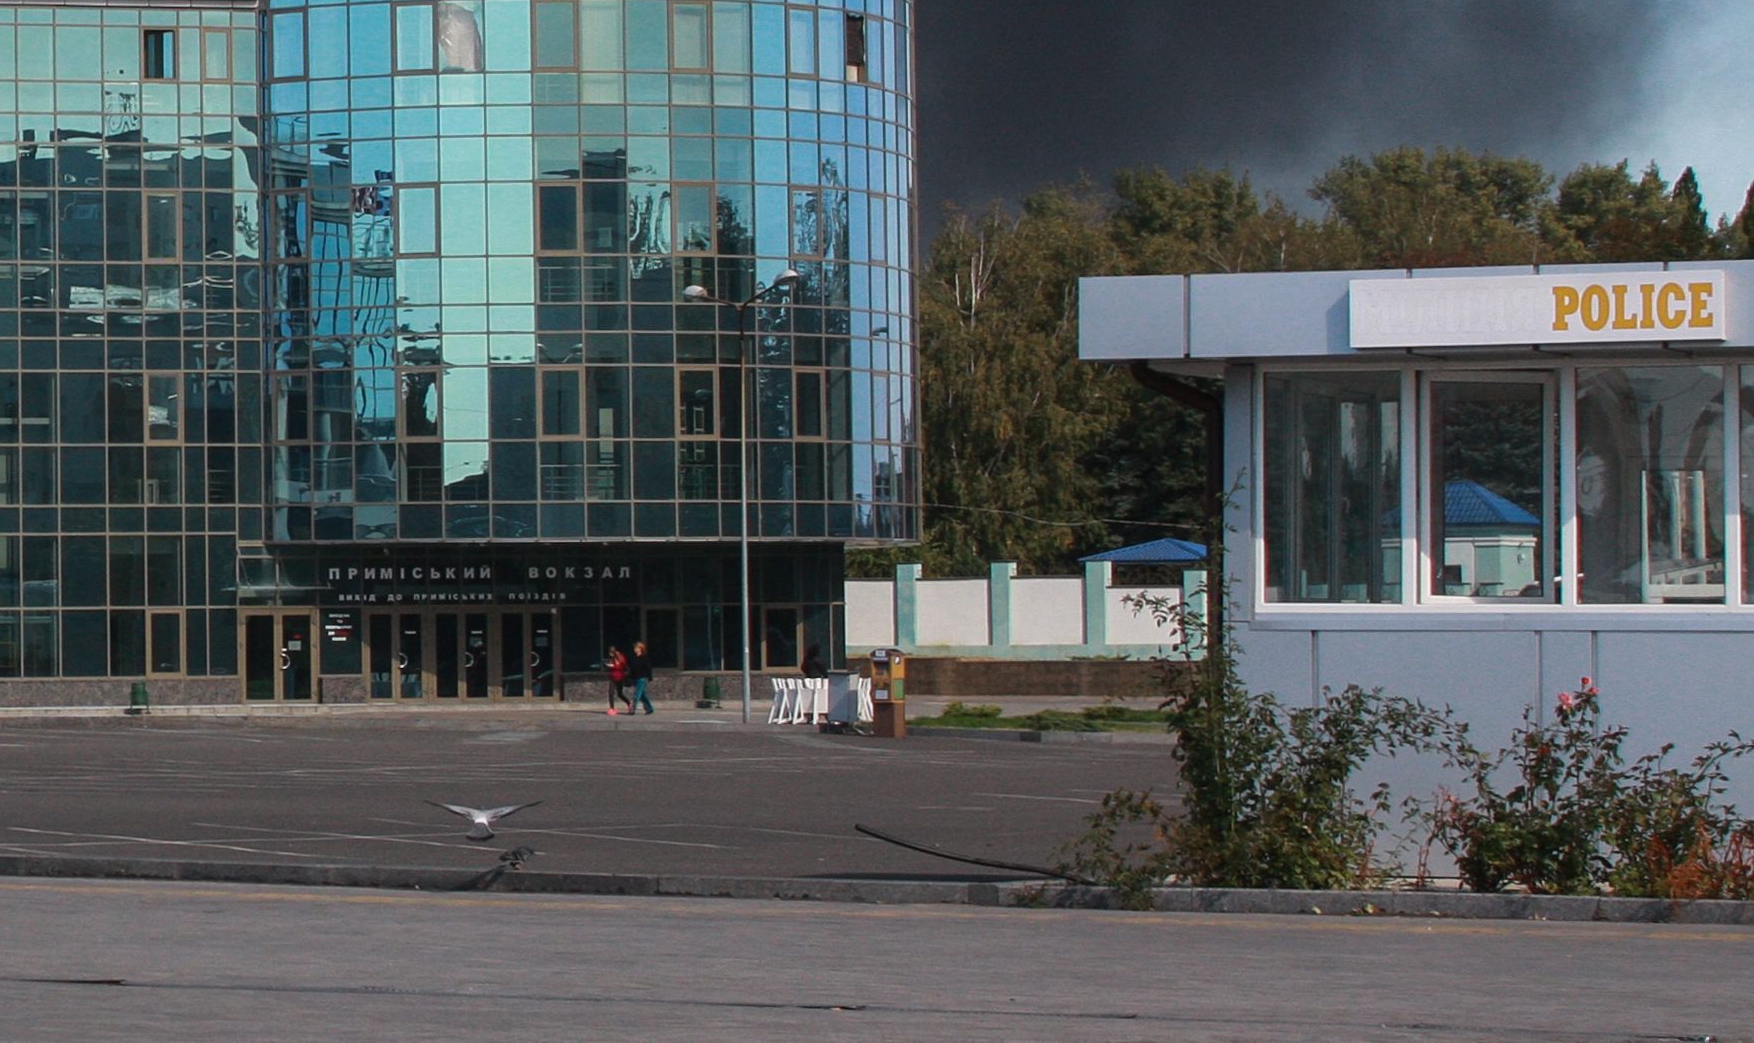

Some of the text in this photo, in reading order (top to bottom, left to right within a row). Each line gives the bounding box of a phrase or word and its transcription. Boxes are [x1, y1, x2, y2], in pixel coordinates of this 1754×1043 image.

[1552, 282, 1714, 332] POLICE
[328, 565, 631, 580] ПРИМІСЬКИЙ ВОКЗАЛ
[387, 593, 403, 602] ДО
